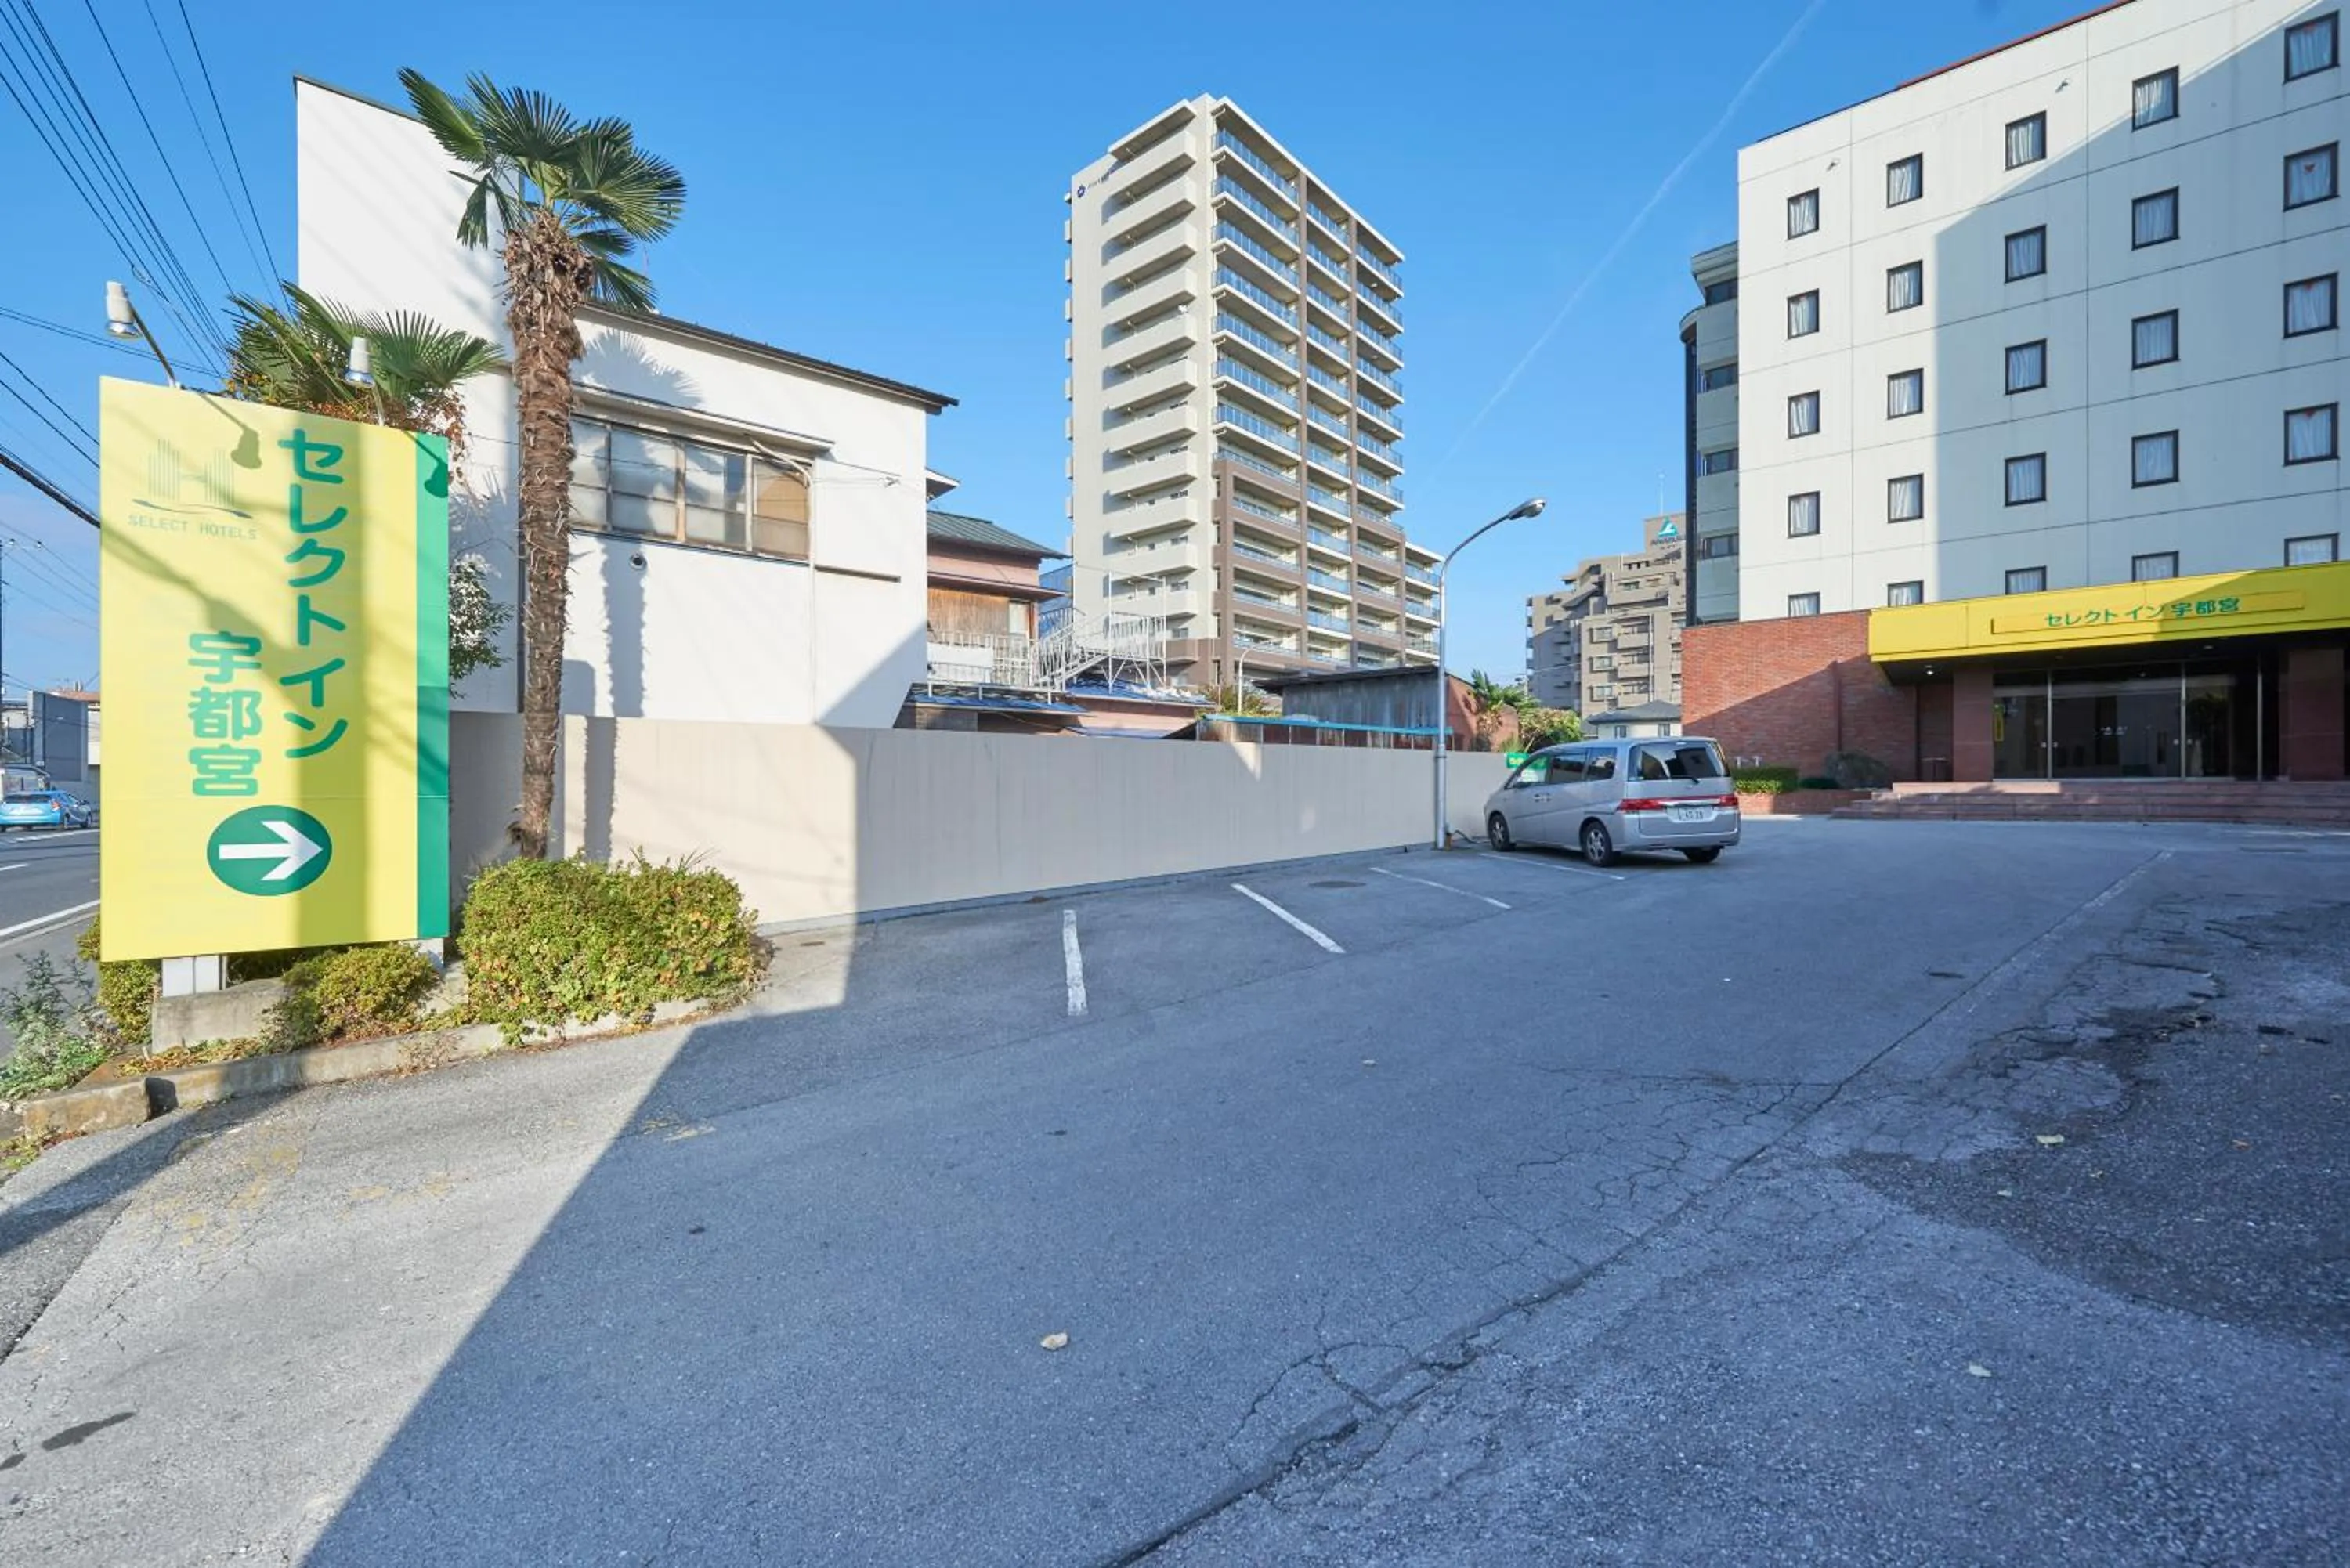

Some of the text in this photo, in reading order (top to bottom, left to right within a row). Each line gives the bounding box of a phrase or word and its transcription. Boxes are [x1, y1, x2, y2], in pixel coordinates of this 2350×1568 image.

[128, 514, 258, 540] SELECT HOTELS
[277, 428, 349, 758] セレクトイン
[187, 630, 262, 797] 宇都宮
